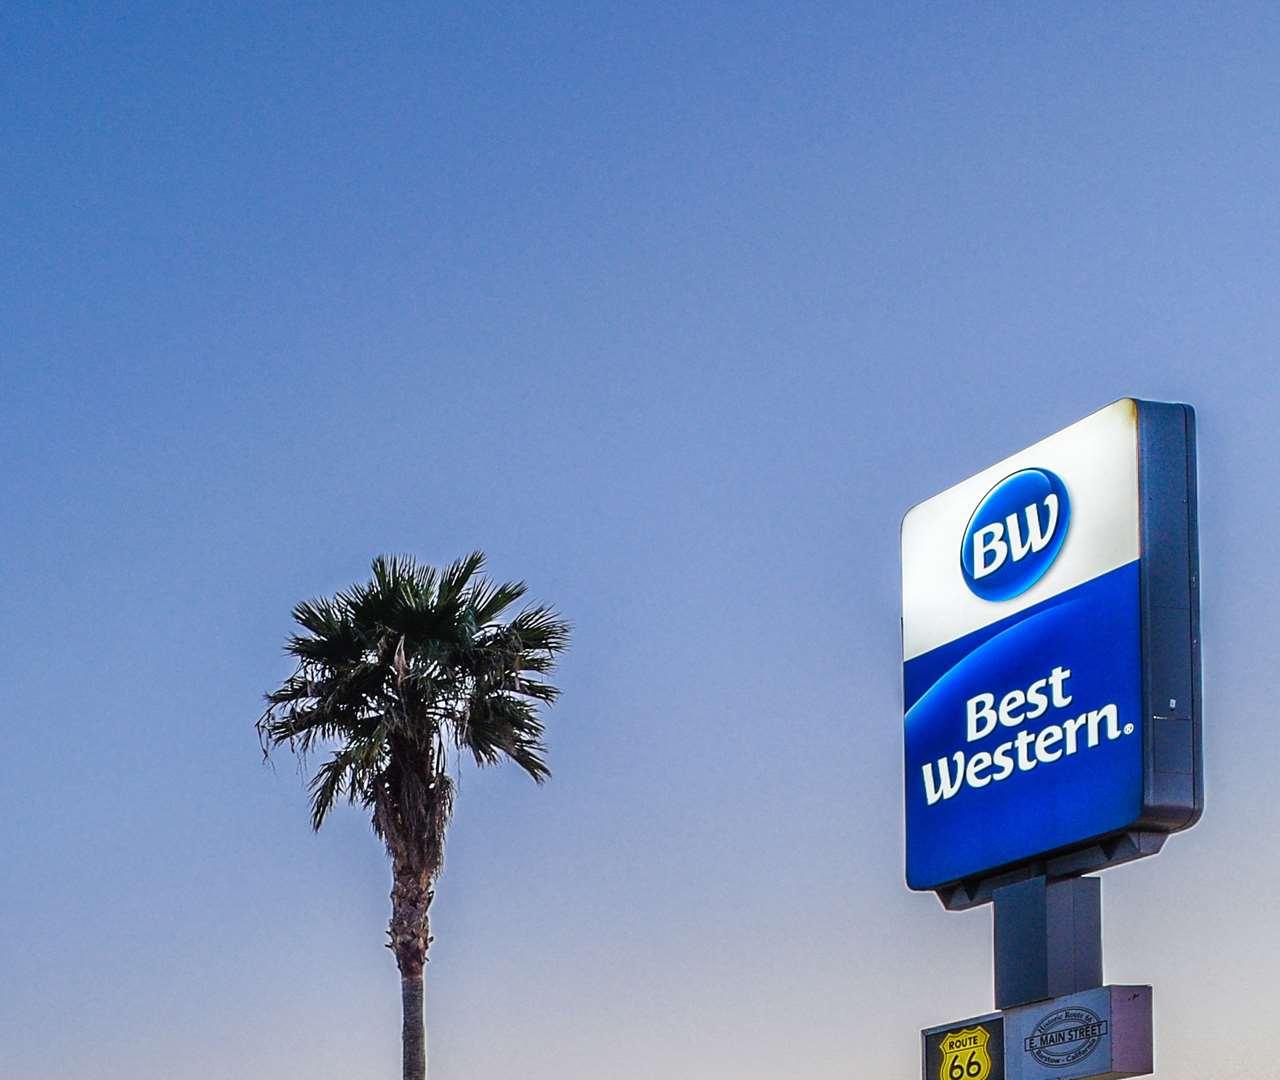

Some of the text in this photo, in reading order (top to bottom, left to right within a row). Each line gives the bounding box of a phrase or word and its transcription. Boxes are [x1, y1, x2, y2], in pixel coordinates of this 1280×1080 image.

[973, 493, 1059, 580] BW
[966, 666, 1072, 743] Best
[948, 1035, 979, 1050] ROUTE
[1040, 1031, 1065, 1046] MAIN
[1068, 1023, 1103, 1040] STREET
[948, 1050, 981, 1080] 66
